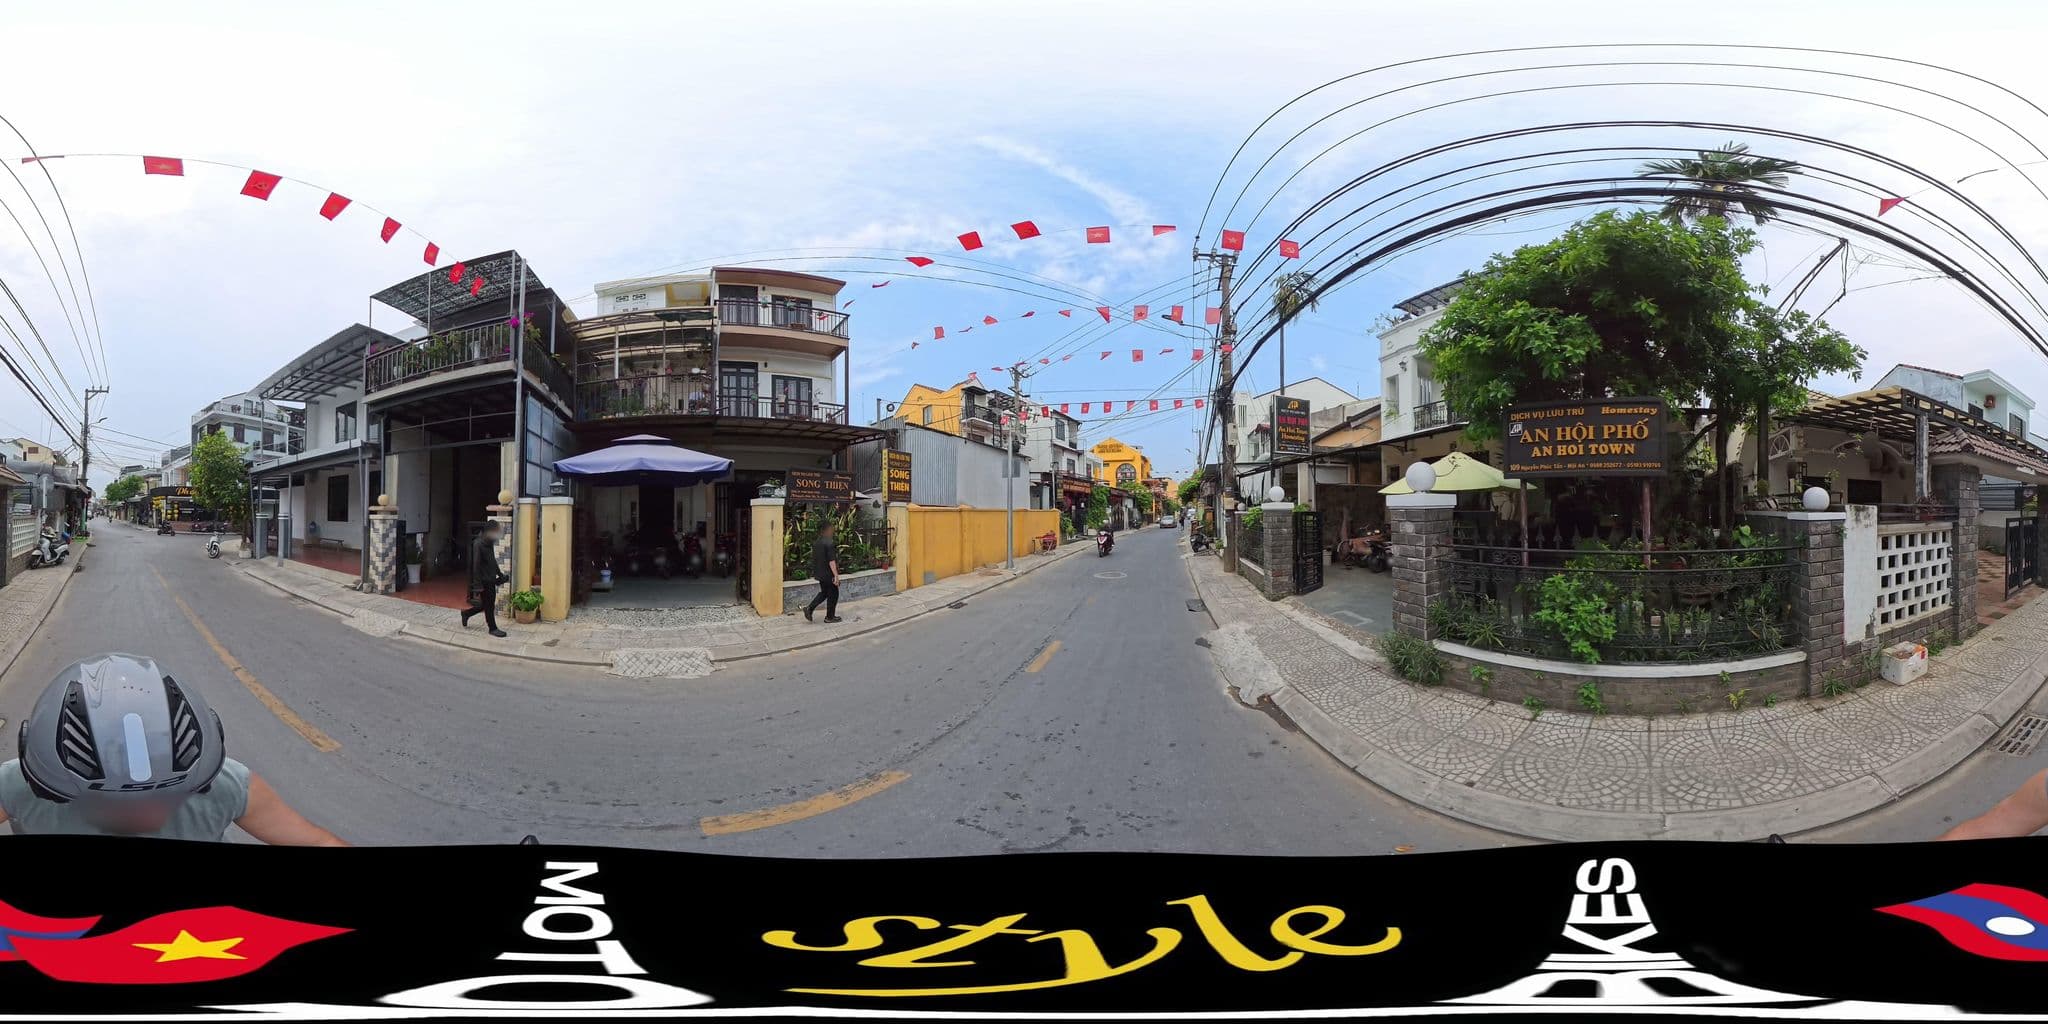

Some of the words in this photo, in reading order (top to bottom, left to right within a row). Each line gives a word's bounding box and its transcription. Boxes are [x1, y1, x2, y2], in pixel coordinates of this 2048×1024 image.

[1601, 406, 1658, 416] Homestay
[1519, 427, 1550, 444] AN
[1556, 421, 1595, 443] HỘI
[1603, 417, 1649, 440] PHỐ
[1531, 446, 1553, 458] AN
[1557, 444, 1584, 456] HOI
[1588, 443, 1635, 455] TOWN
[890, 469, 910, 480] SONG
[796, 479, 821, 489] SONG
